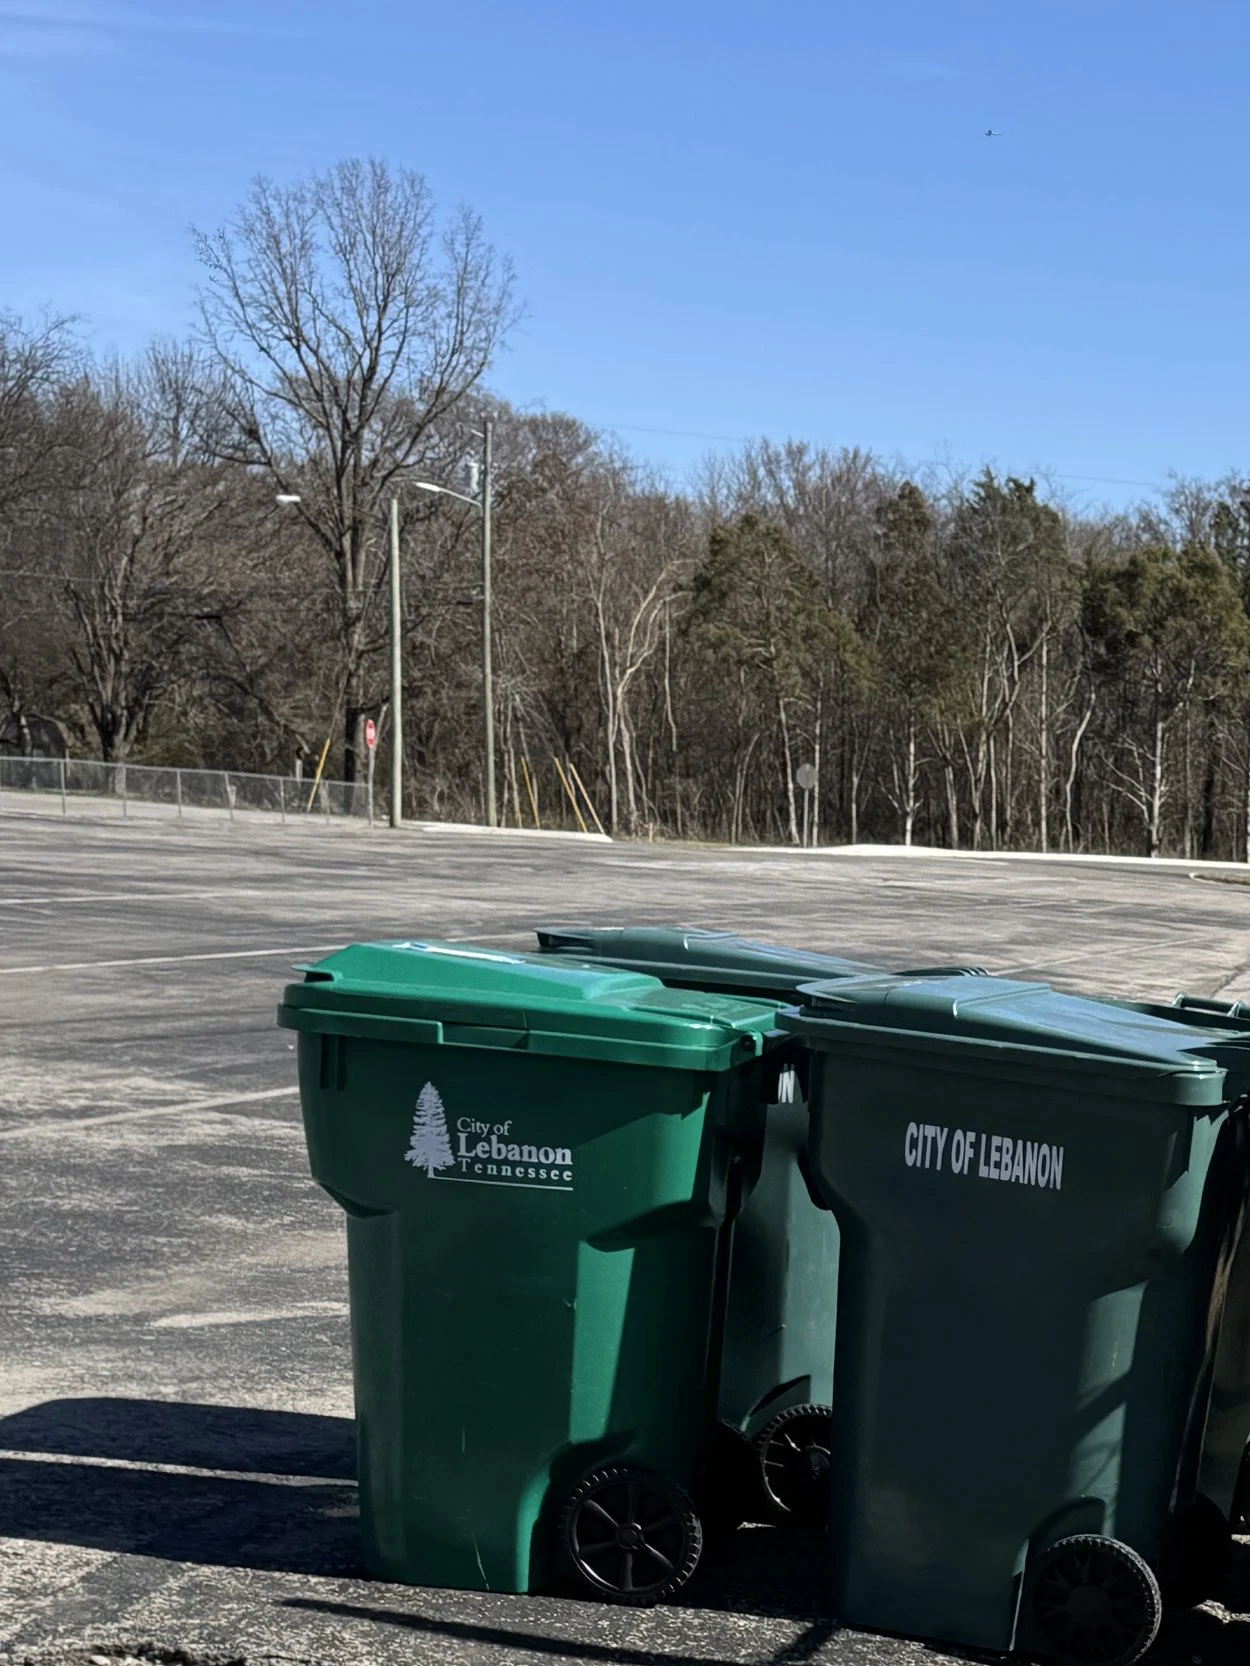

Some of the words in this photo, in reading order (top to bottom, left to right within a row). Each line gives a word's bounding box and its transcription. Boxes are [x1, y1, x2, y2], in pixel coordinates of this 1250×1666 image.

[456, 1117, 491, 1138] City
[493, 1120, 513, 1136] of
[456, 1132, 574, 1165] Lebanon
[904, 1121, 949, 1171] CITY
[951, 1128, 976, 1175] OF
[978, 1133, 1065, 1190] LEBANON
[457, 1157, 573, 1182] Tennessee
